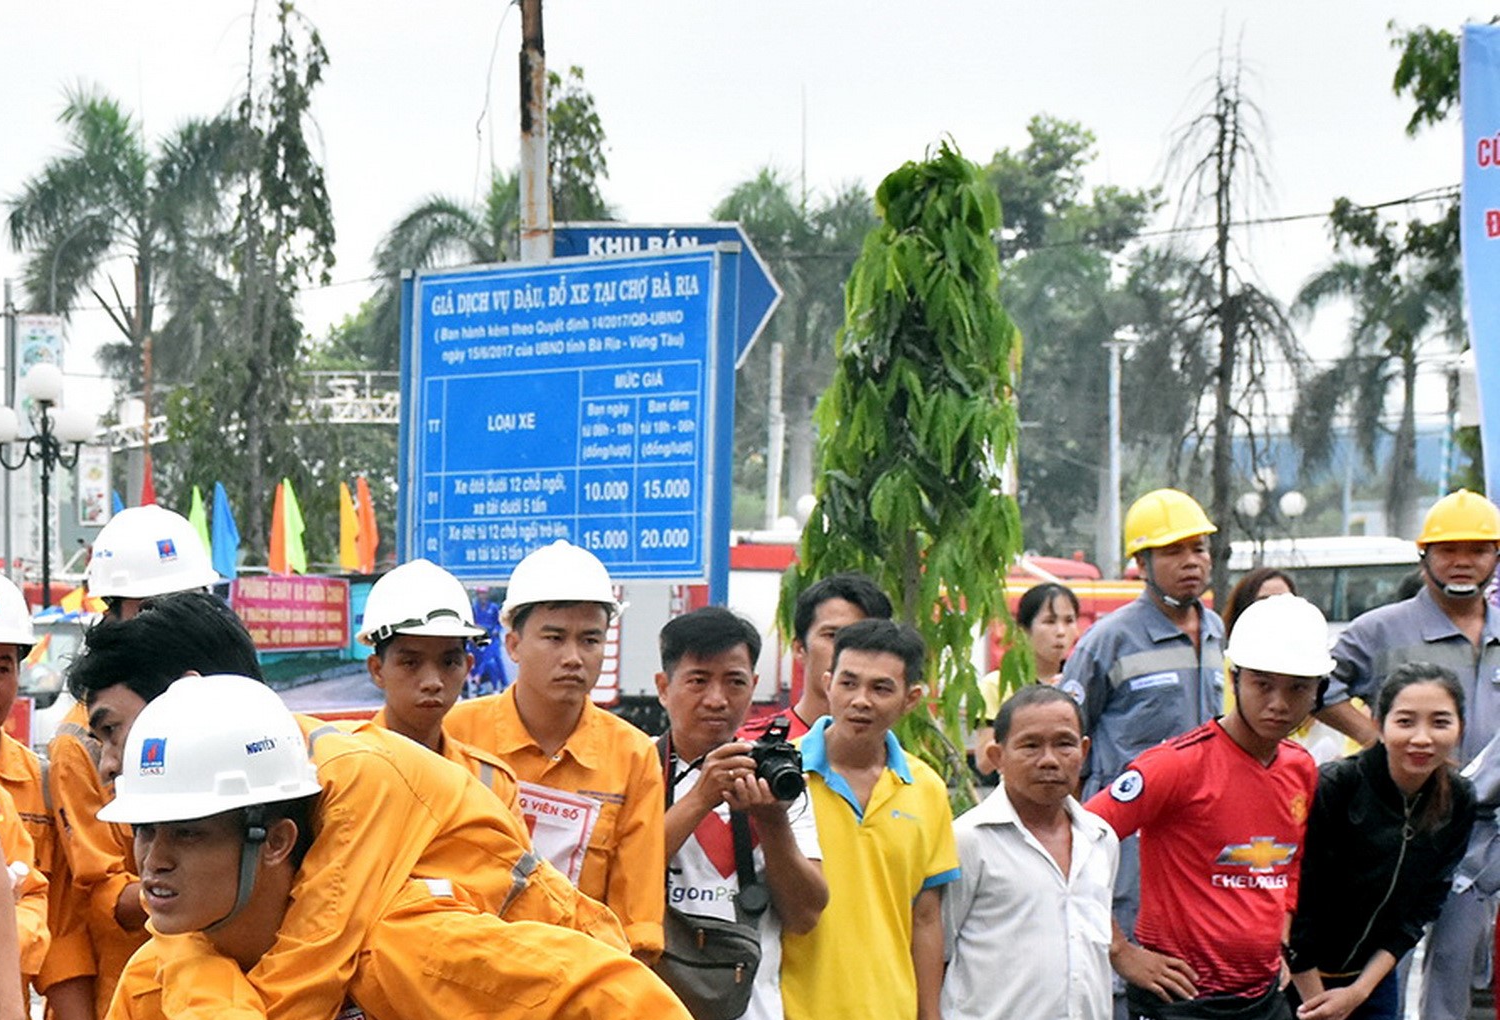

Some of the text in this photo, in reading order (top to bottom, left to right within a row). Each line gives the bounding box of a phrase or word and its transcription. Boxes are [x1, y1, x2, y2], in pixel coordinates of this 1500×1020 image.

[431, 289, 454, 316] GIÁ
[457, 291, 489, 318] DỊCH
[492, 290, 510, 315] VỤ
[570, 284, 590, 305] XE
[593, 281, 617, 306] TẠI
[619, 275, 649, 304] CHỢ
[651, 271, 672, 298] BÀ
[675, 275, 699, 300] RỊA
[614, 368, 664, 389] MỨC GIÁ
[428, 418, 441, 433] TT
[487, 412, 536, 434] LOẠI XE
[454, 480, 467, 494] Xe
[509, 476, 521, 491] 12
[584, 481, 629, 501] 10.000
[643, 478, 691, 499] 15.000
[523, 498, 530, 514] 5
[448, 525, 460, 540] Xe
[489, 524, 500, 539] 12
[583, 529, 629, 549] 15.000
[641, 528, 690, 548] 20.000
[531, 800, 560, 816] VIÊN
[561, 808, 580, 821] SỐ
